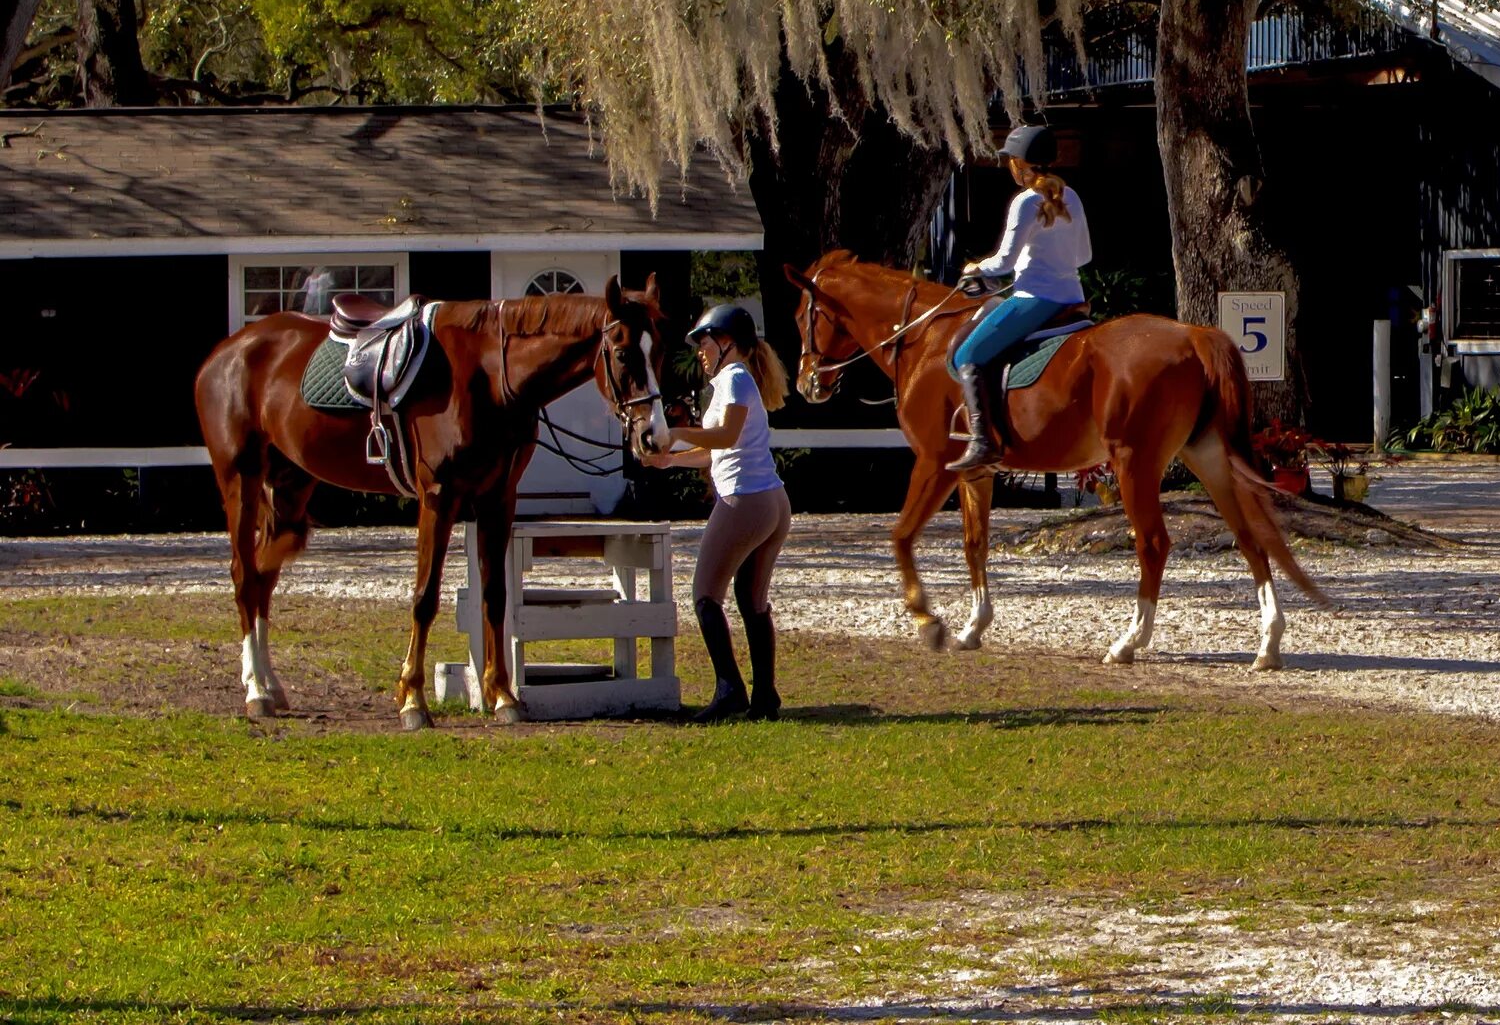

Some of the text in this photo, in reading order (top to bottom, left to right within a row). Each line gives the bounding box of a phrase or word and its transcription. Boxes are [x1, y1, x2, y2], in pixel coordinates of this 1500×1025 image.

[1232, 298, 1272, 313] Speed
[1240, 316, 1268, 353] 5
[1246, 363, 1270, 375] mit
